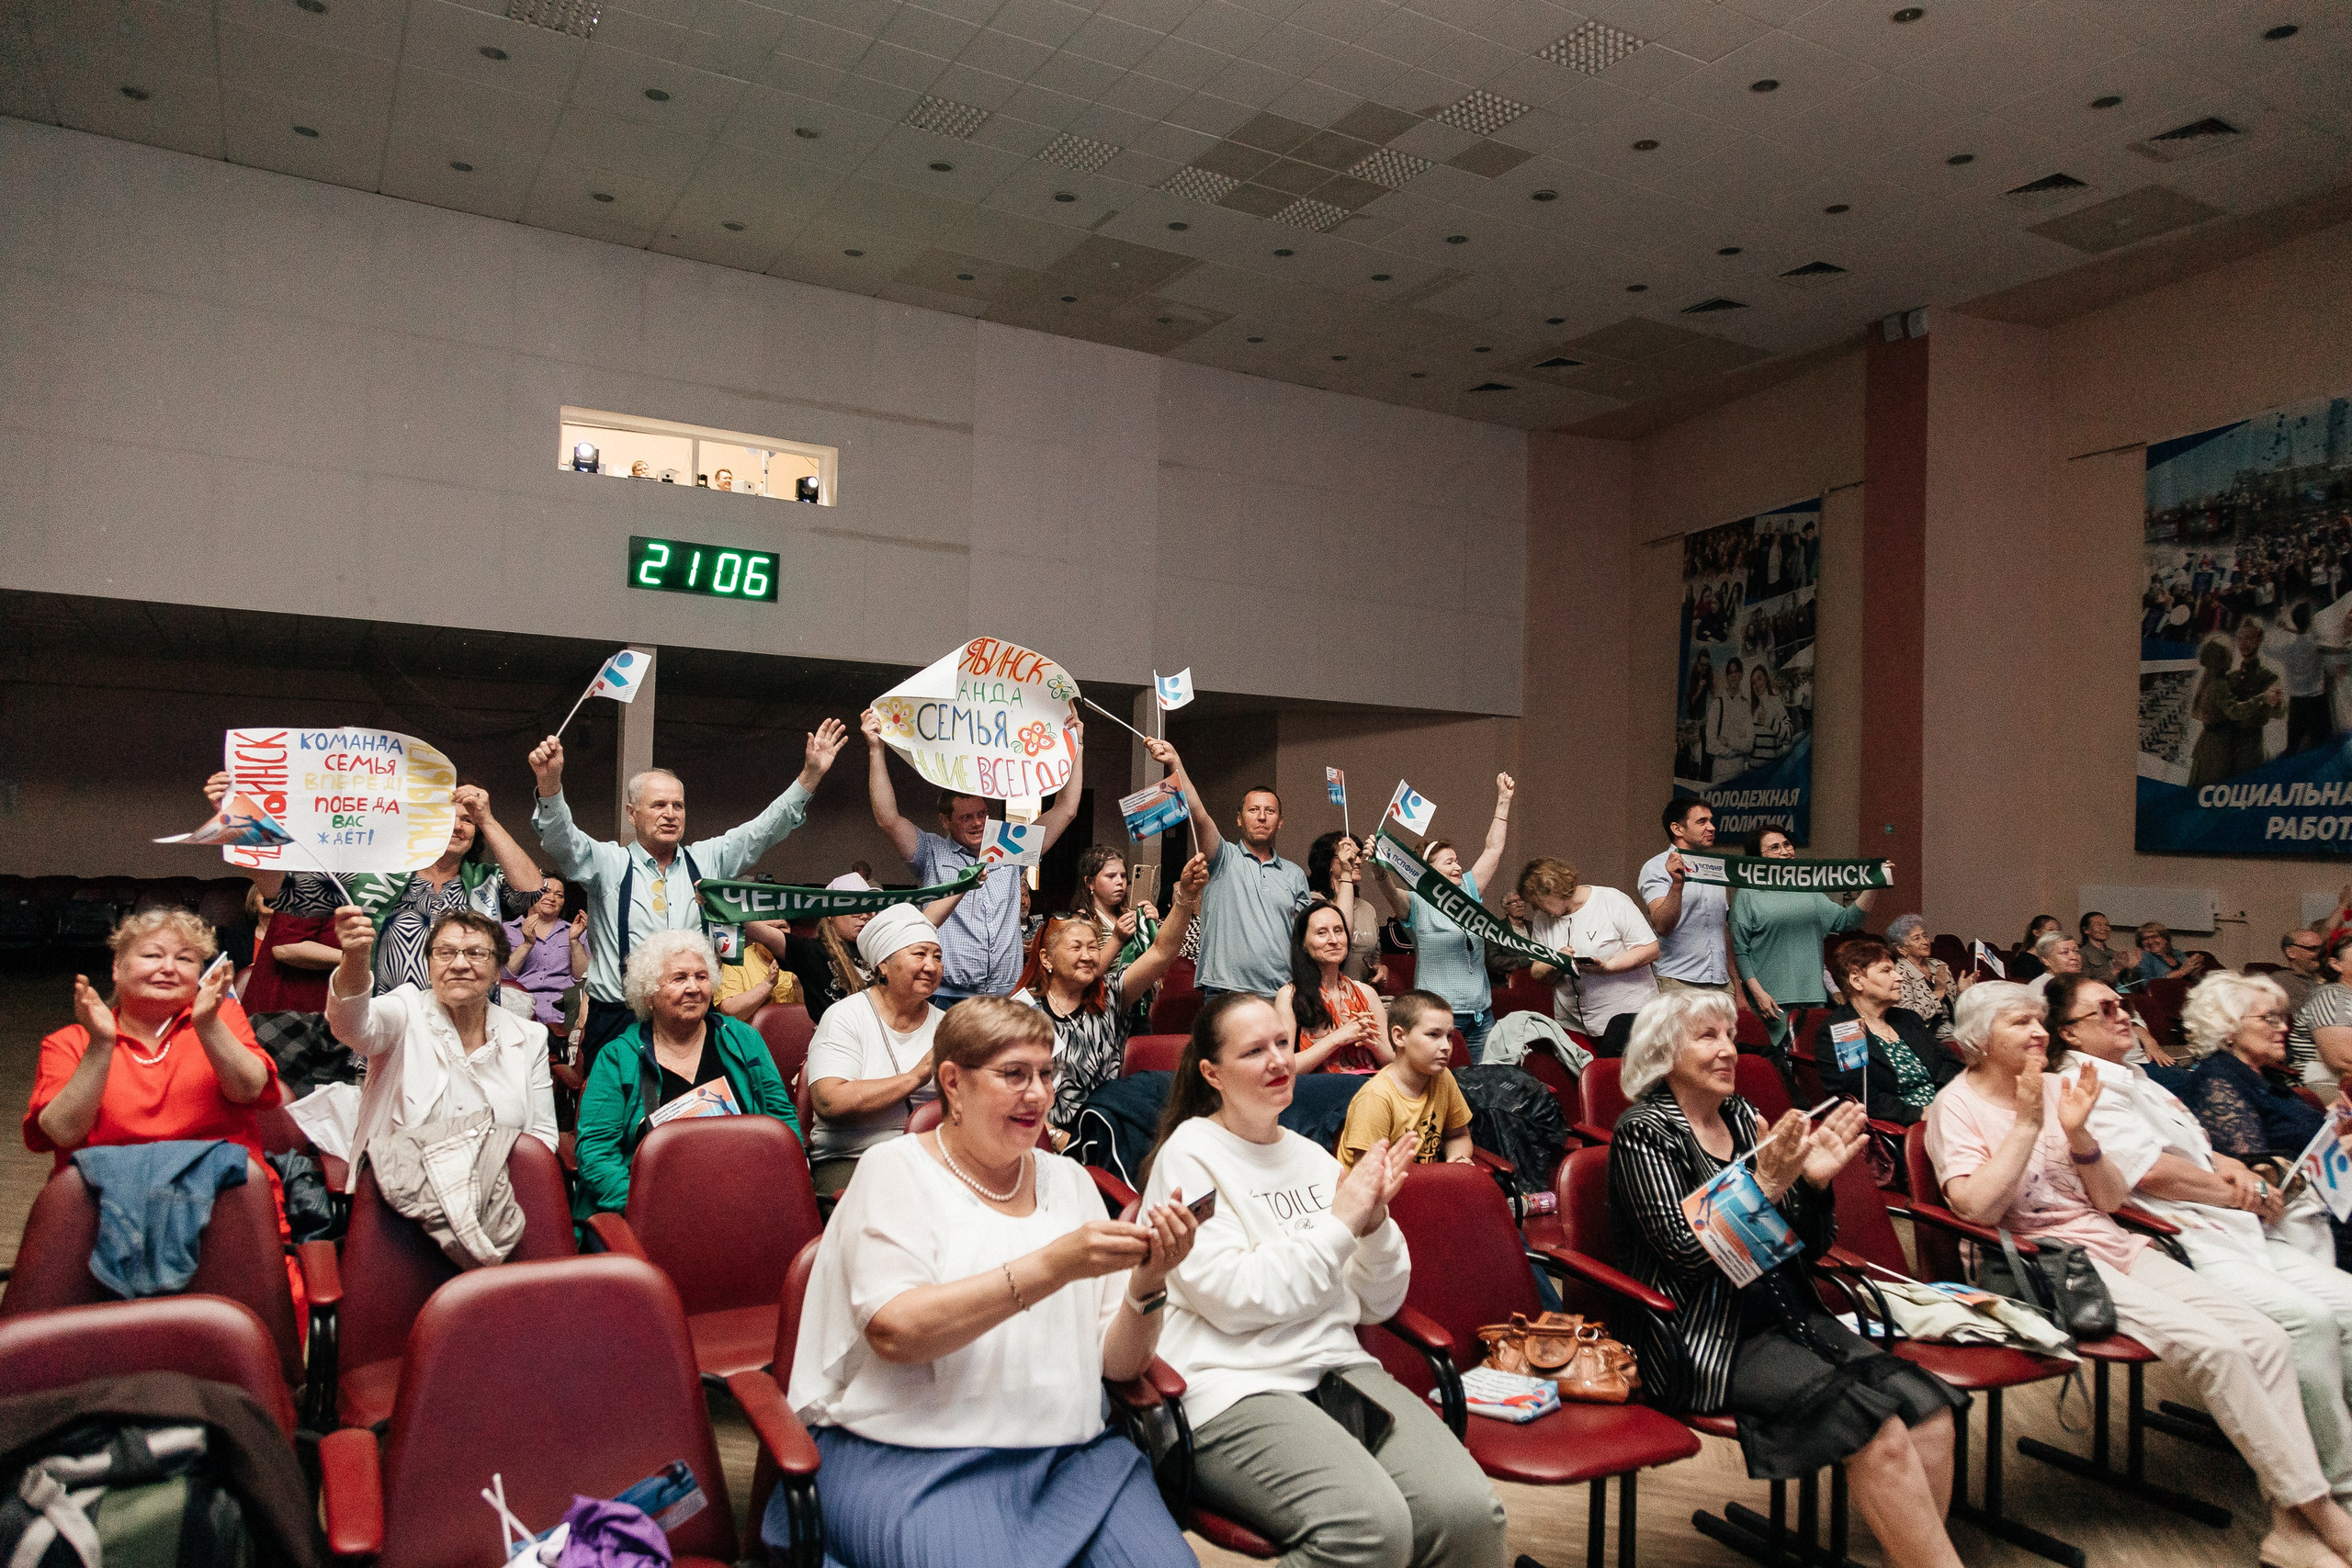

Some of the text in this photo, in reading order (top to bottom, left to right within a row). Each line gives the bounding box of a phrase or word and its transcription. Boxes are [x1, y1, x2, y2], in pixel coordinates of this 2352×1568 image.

[957, 637, 1054, 685] ЯБИНСК
[956, 680, 1023, 708] АНДА
[917, 703, 1009, 749] СЕМЬЯ
[300, 732, 404, 755] КОМАНДА
[324, 753, 397, 776] СЕМЬЯ
[233, 731, 288, 868] ЧЕИНСК
[314, 795, 401, 815] ПОБЕДА
[406, 742, 456, 867] ЕЛЯБИНСК
[2198, 781, 2352, 810] СОЦИАЛЬНА
[332, 815, 366, 829] ВАС
[1719, 814, 1795, 833] ПОЛИТИКА
[2265, 816, 2352, 840] РАБОТ
[1737, 863, 1873, 887] ЧЕЛЯБИНСК
[1432, 883, 1565, 964] ЧЕЛЯБИНСК
